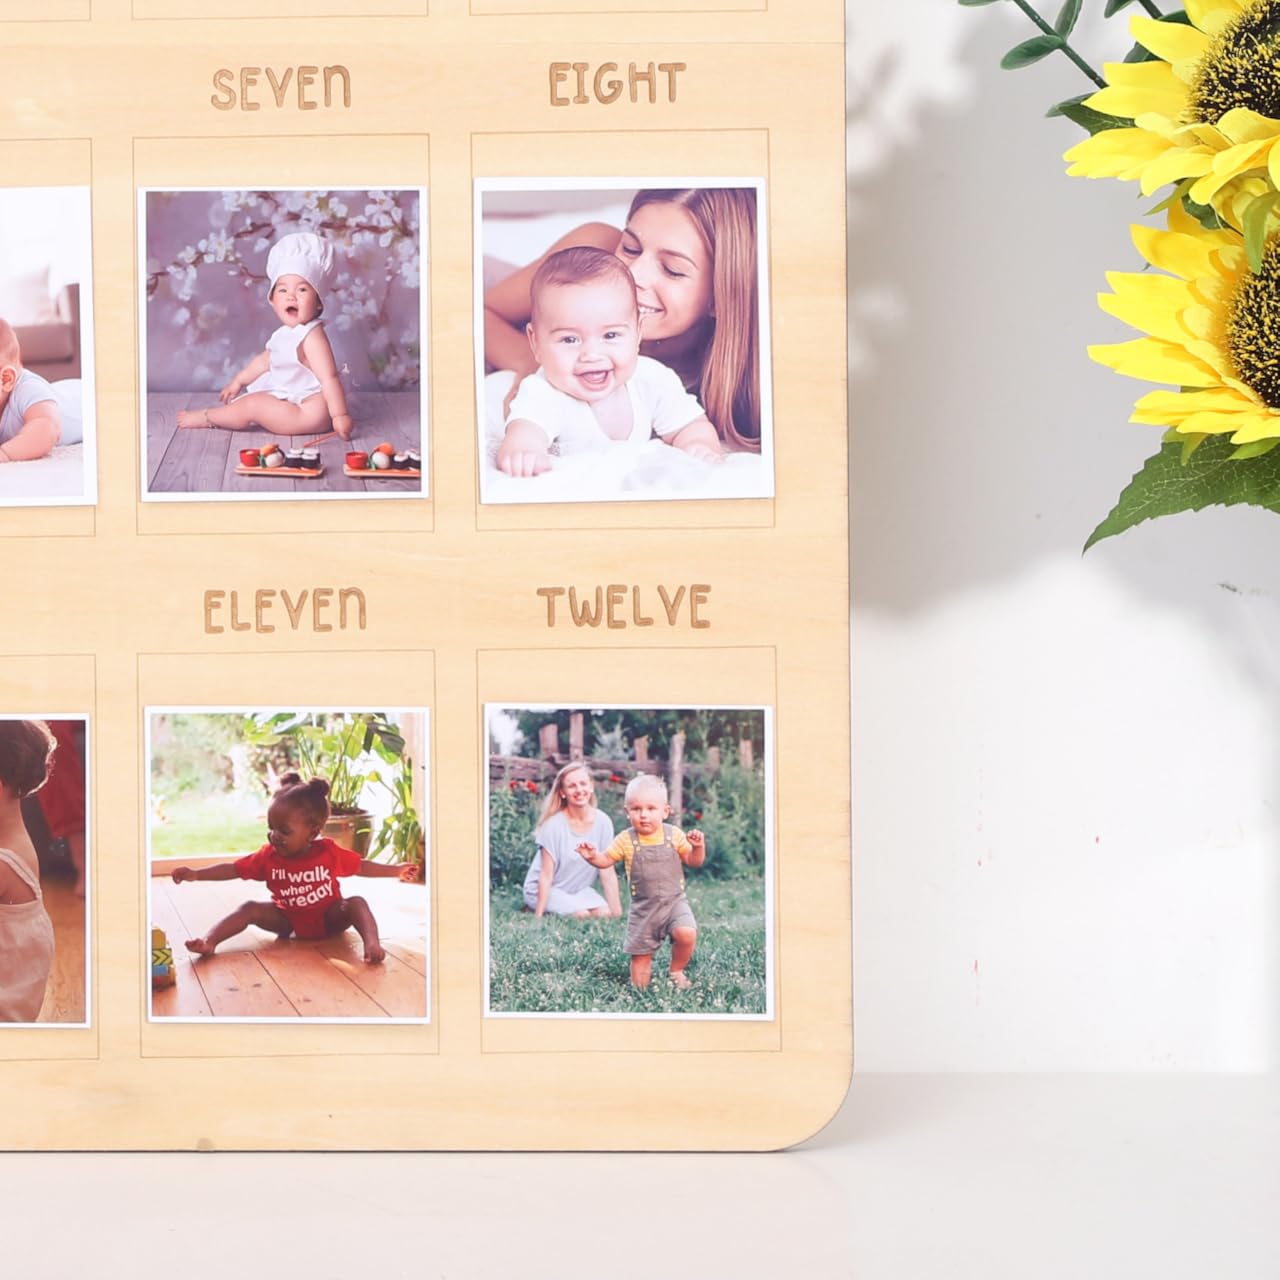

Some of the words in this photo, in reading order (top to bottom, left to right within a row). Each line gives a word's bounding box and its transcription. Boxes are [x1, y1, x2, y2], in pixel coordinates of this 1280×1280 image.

[549, 62, 687, 107] EIGHT
[536, 583, 711, 629] TWELVE
[287, 865, 332, 883] walk
[280, 884, 313, 897] when
